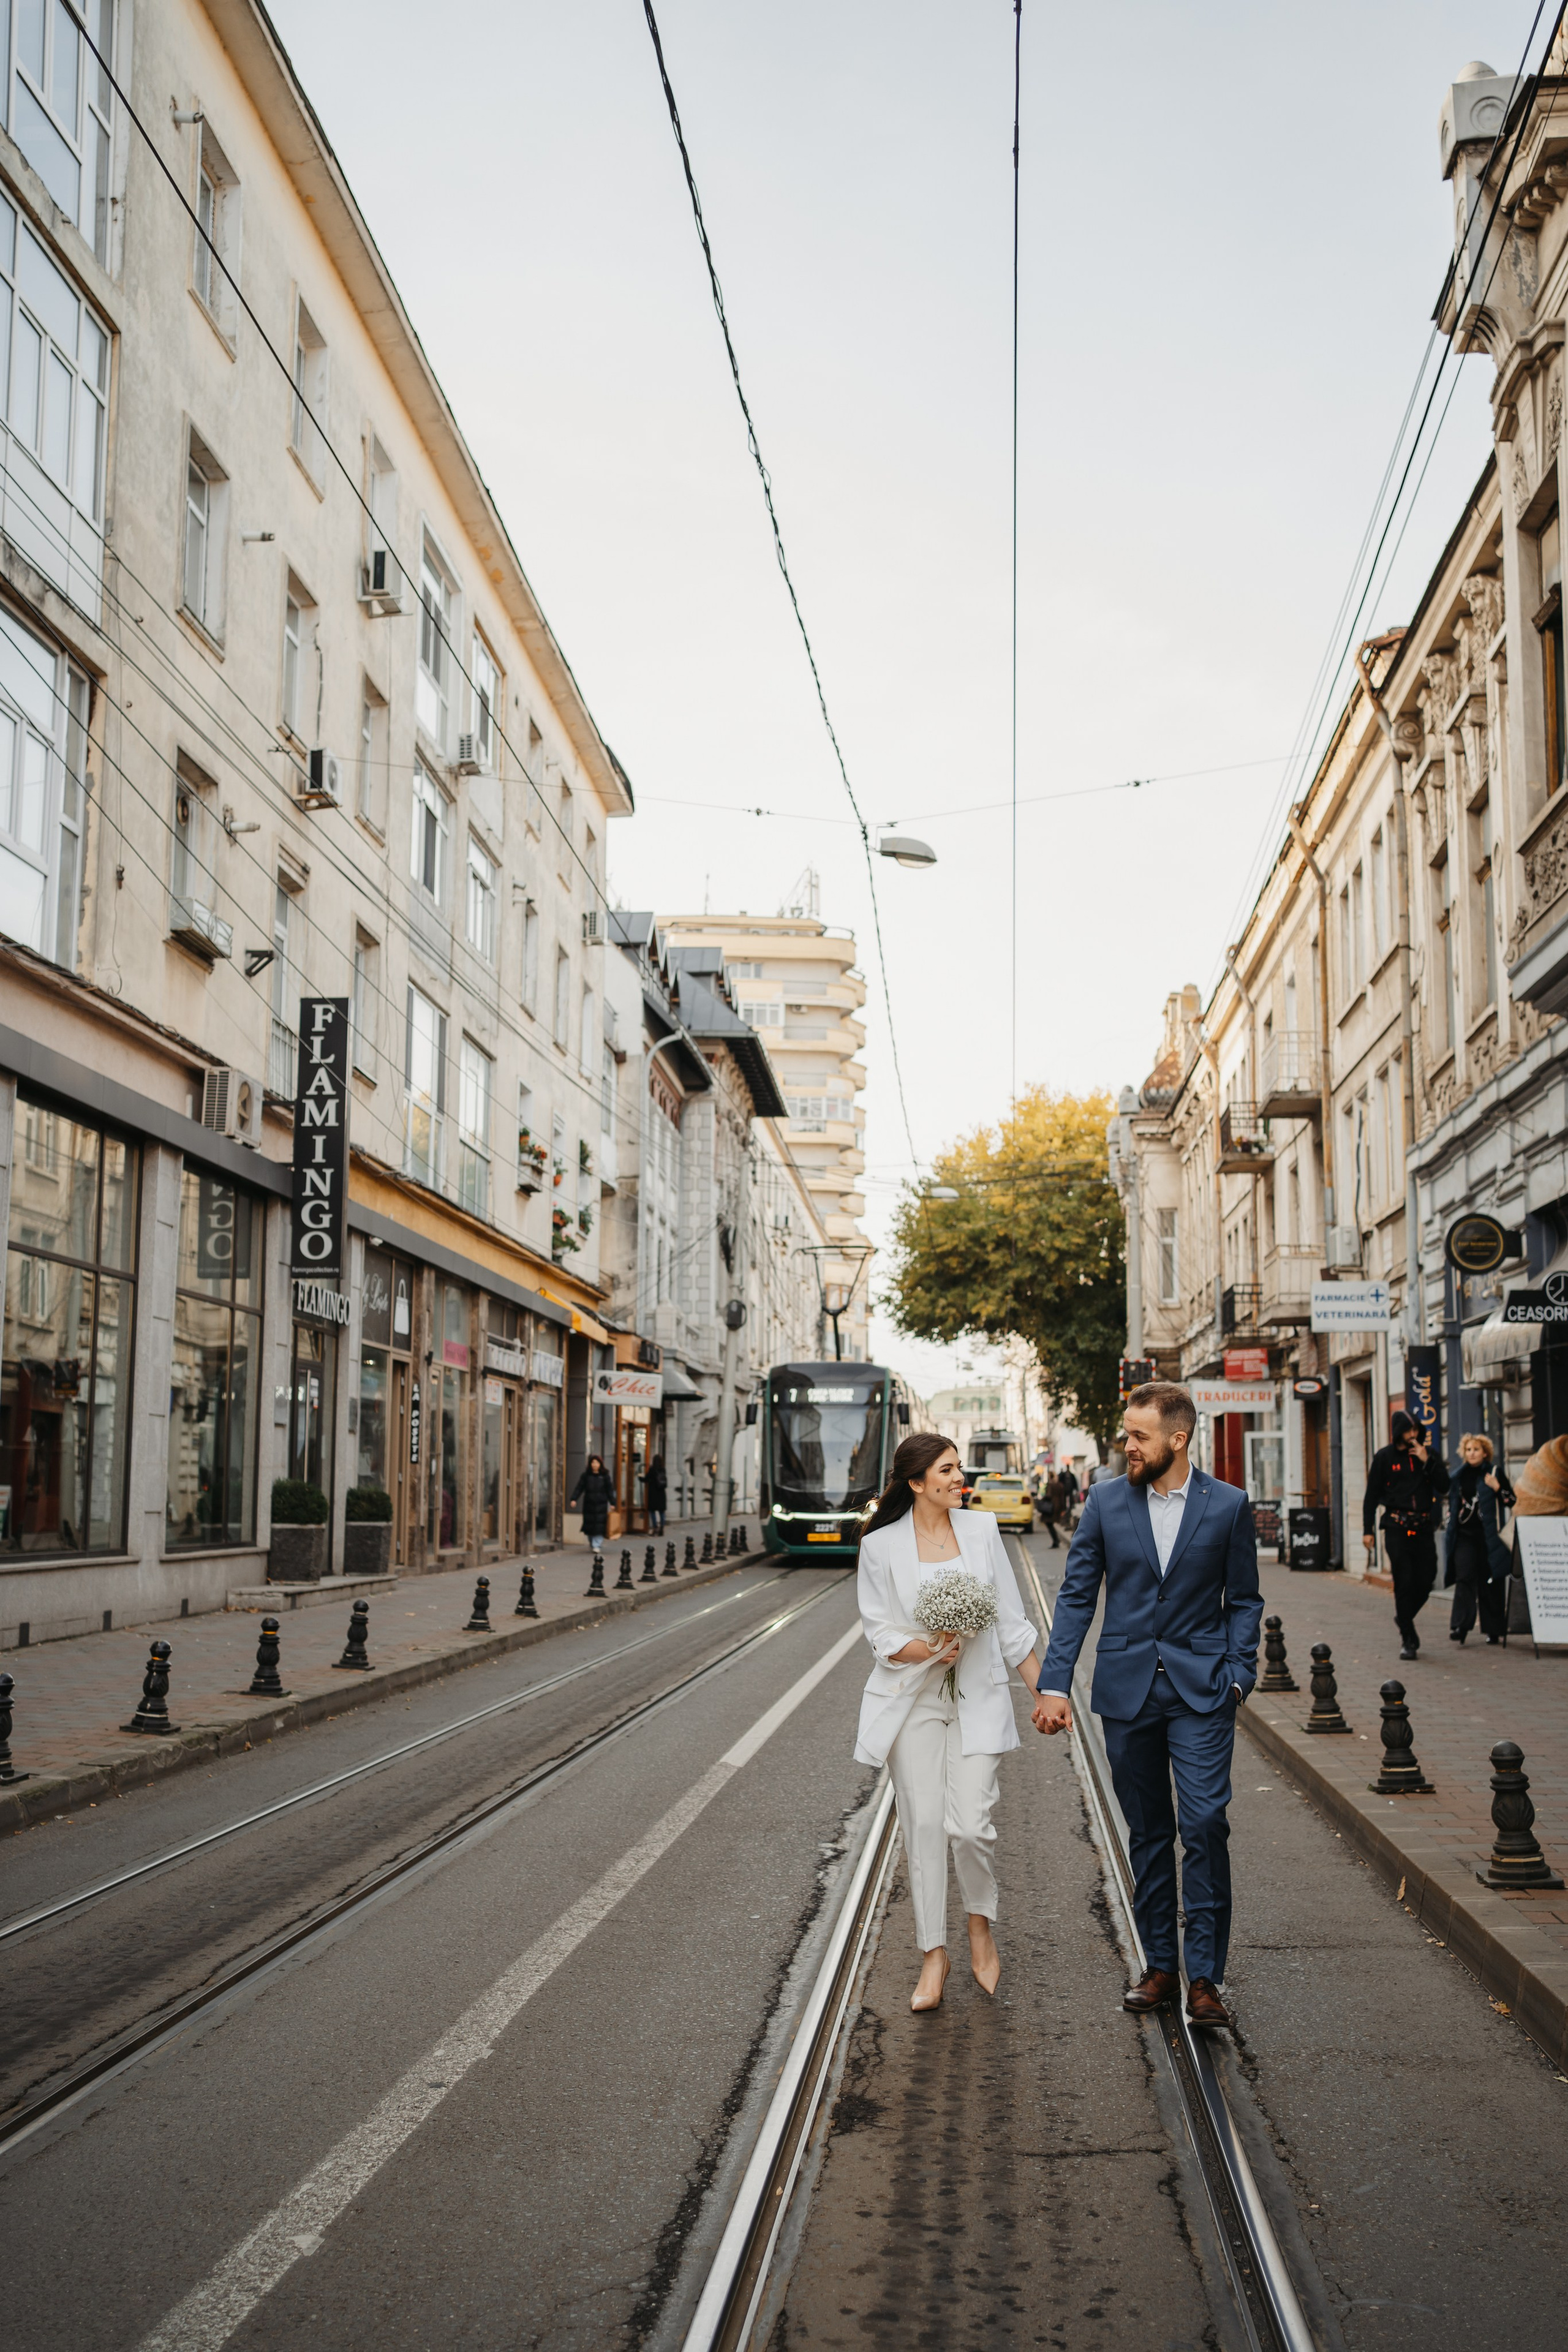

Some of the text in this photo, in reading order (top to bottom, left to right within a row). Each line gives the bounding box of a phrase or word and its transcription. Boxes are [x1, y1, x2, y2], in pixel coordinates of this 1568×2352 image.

[300, 1003, 339, 1261] FLAMINGO
[296, 1281, 350, 1326] FLAMINGO
[1196, 1390, 1272, 1403] TRADUCERI
